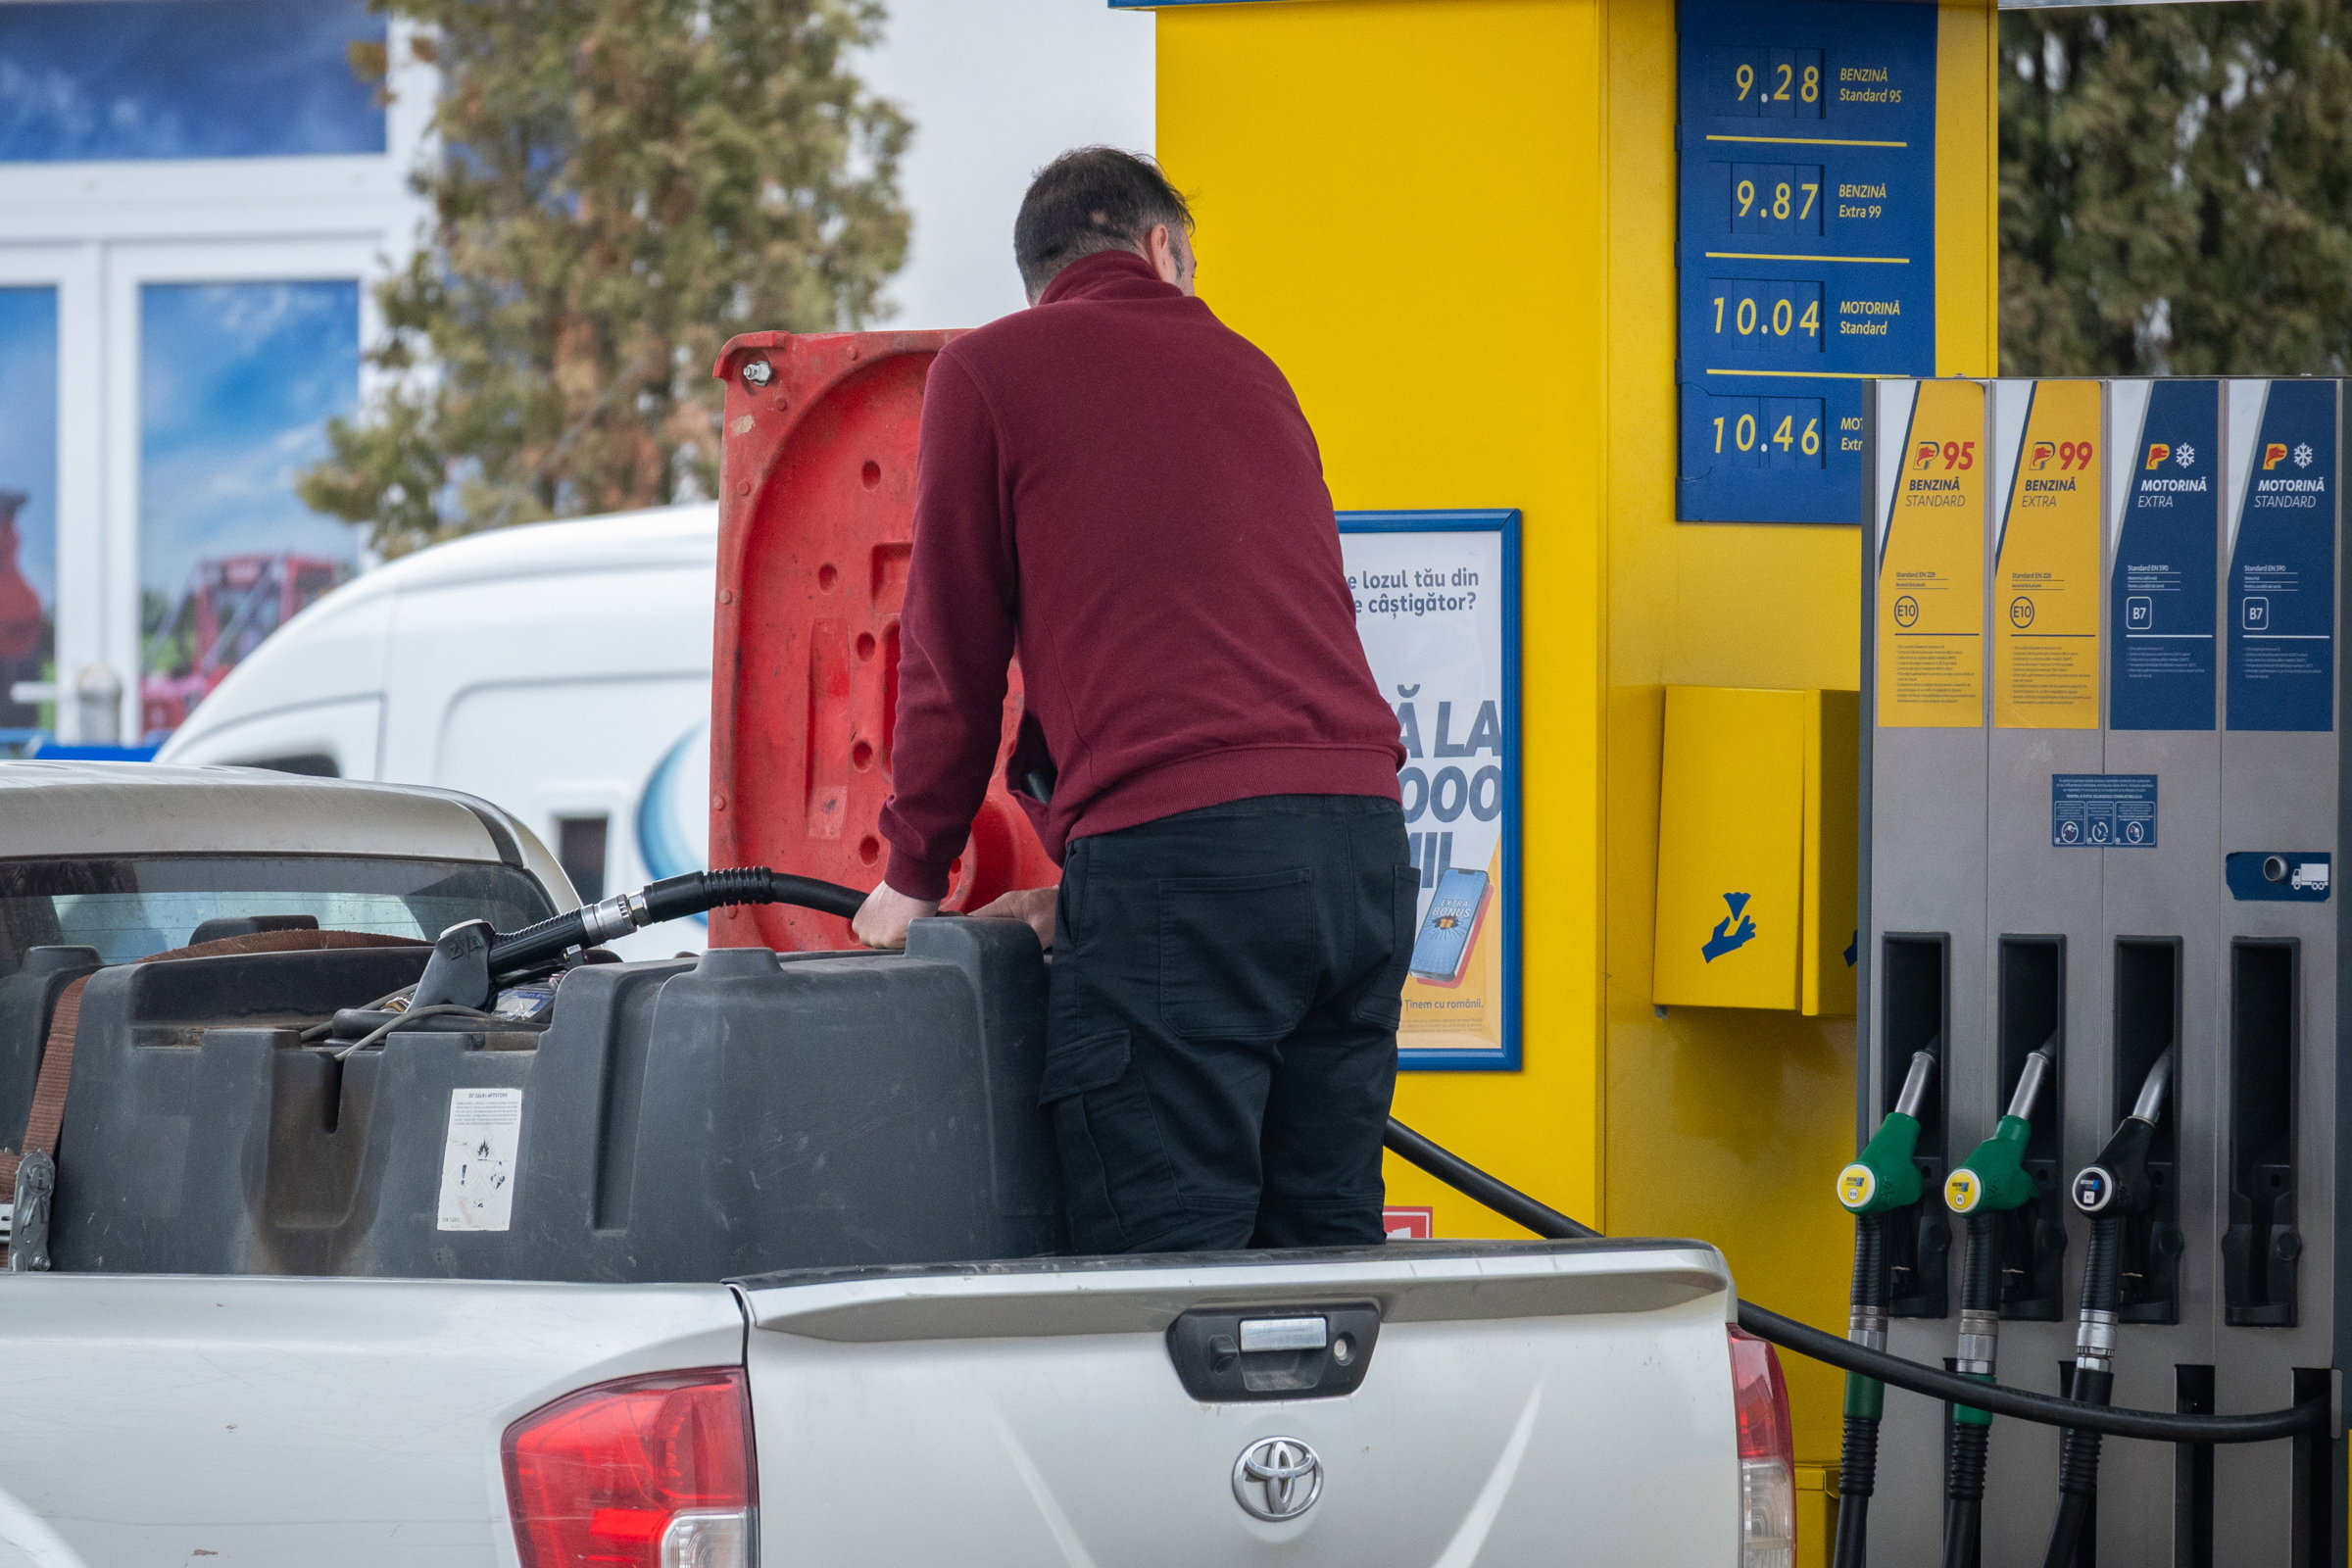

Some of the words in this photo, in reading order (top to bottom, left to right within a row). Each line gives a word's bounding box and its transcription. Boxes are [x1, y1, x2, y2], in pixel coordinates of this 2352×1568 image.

[1839, 67, 1887, 82] BENZINĂ
[1736, 64, 1819, 103] 9.28
[1839, 88, 1886, 102] Standard
[1889, 89, 1902, 103] 95
[1838, 183, 1886, 199] BENZINĂ
[1737, 180, 1819, 220] 9.87
[1838, 205, 1866, 218] Extra
[1868, 206, 1882, 219] 99
[1839, 300, 1900, 316] MOTORINĂ
[1713, 297, 1820, 337] 10.04
[1839, 320, 1887, 335] Standard
[1713, 414, 1820, 456] 10.46
[1840, 437, 1863, 451] Extr
[1943, 441, 1975, 470] 95
[2059, 441, 2092, 470] 99
[1909, 476, 1960, 491] BENZINĂ
[2025, 477, 2077, 492] BENZINĂ
[2140, 476, 2207, 492] MOTORINĂ
[2257, 476, 2325, 492] MOTORINĂ
[1906, 495, 1966, 508] STANDARD
[2022, 495, 2057, 508] EXTRA
[2137, 495, 2174, 508] EXTRA
[2254, 495, 2317, 509] STANDARD
[1362, 569, 1408, 589] lozul
[1414, 568, 1446, 588] tău
[1450, 567, 1479, 586] din
[1368, 592, 1477, 620] câștigător?
[1897, 605, 1916, 617] E10
[2013, 606, 2032, 618] E10
[2132, 607, 2147, 620] B7
[2249, 607, 2264, 620] B7
[1433, 700, 1501, 759] LA
[1441, 899, 1468, 907] EXTRA
[1433, 906, 1472, 918] BONUS
[1404, 1000, 1433, 1012] Ținem
[1434, 1001, 1445, 1009] cu
[1446, 998, 1484, 1009] românii.
